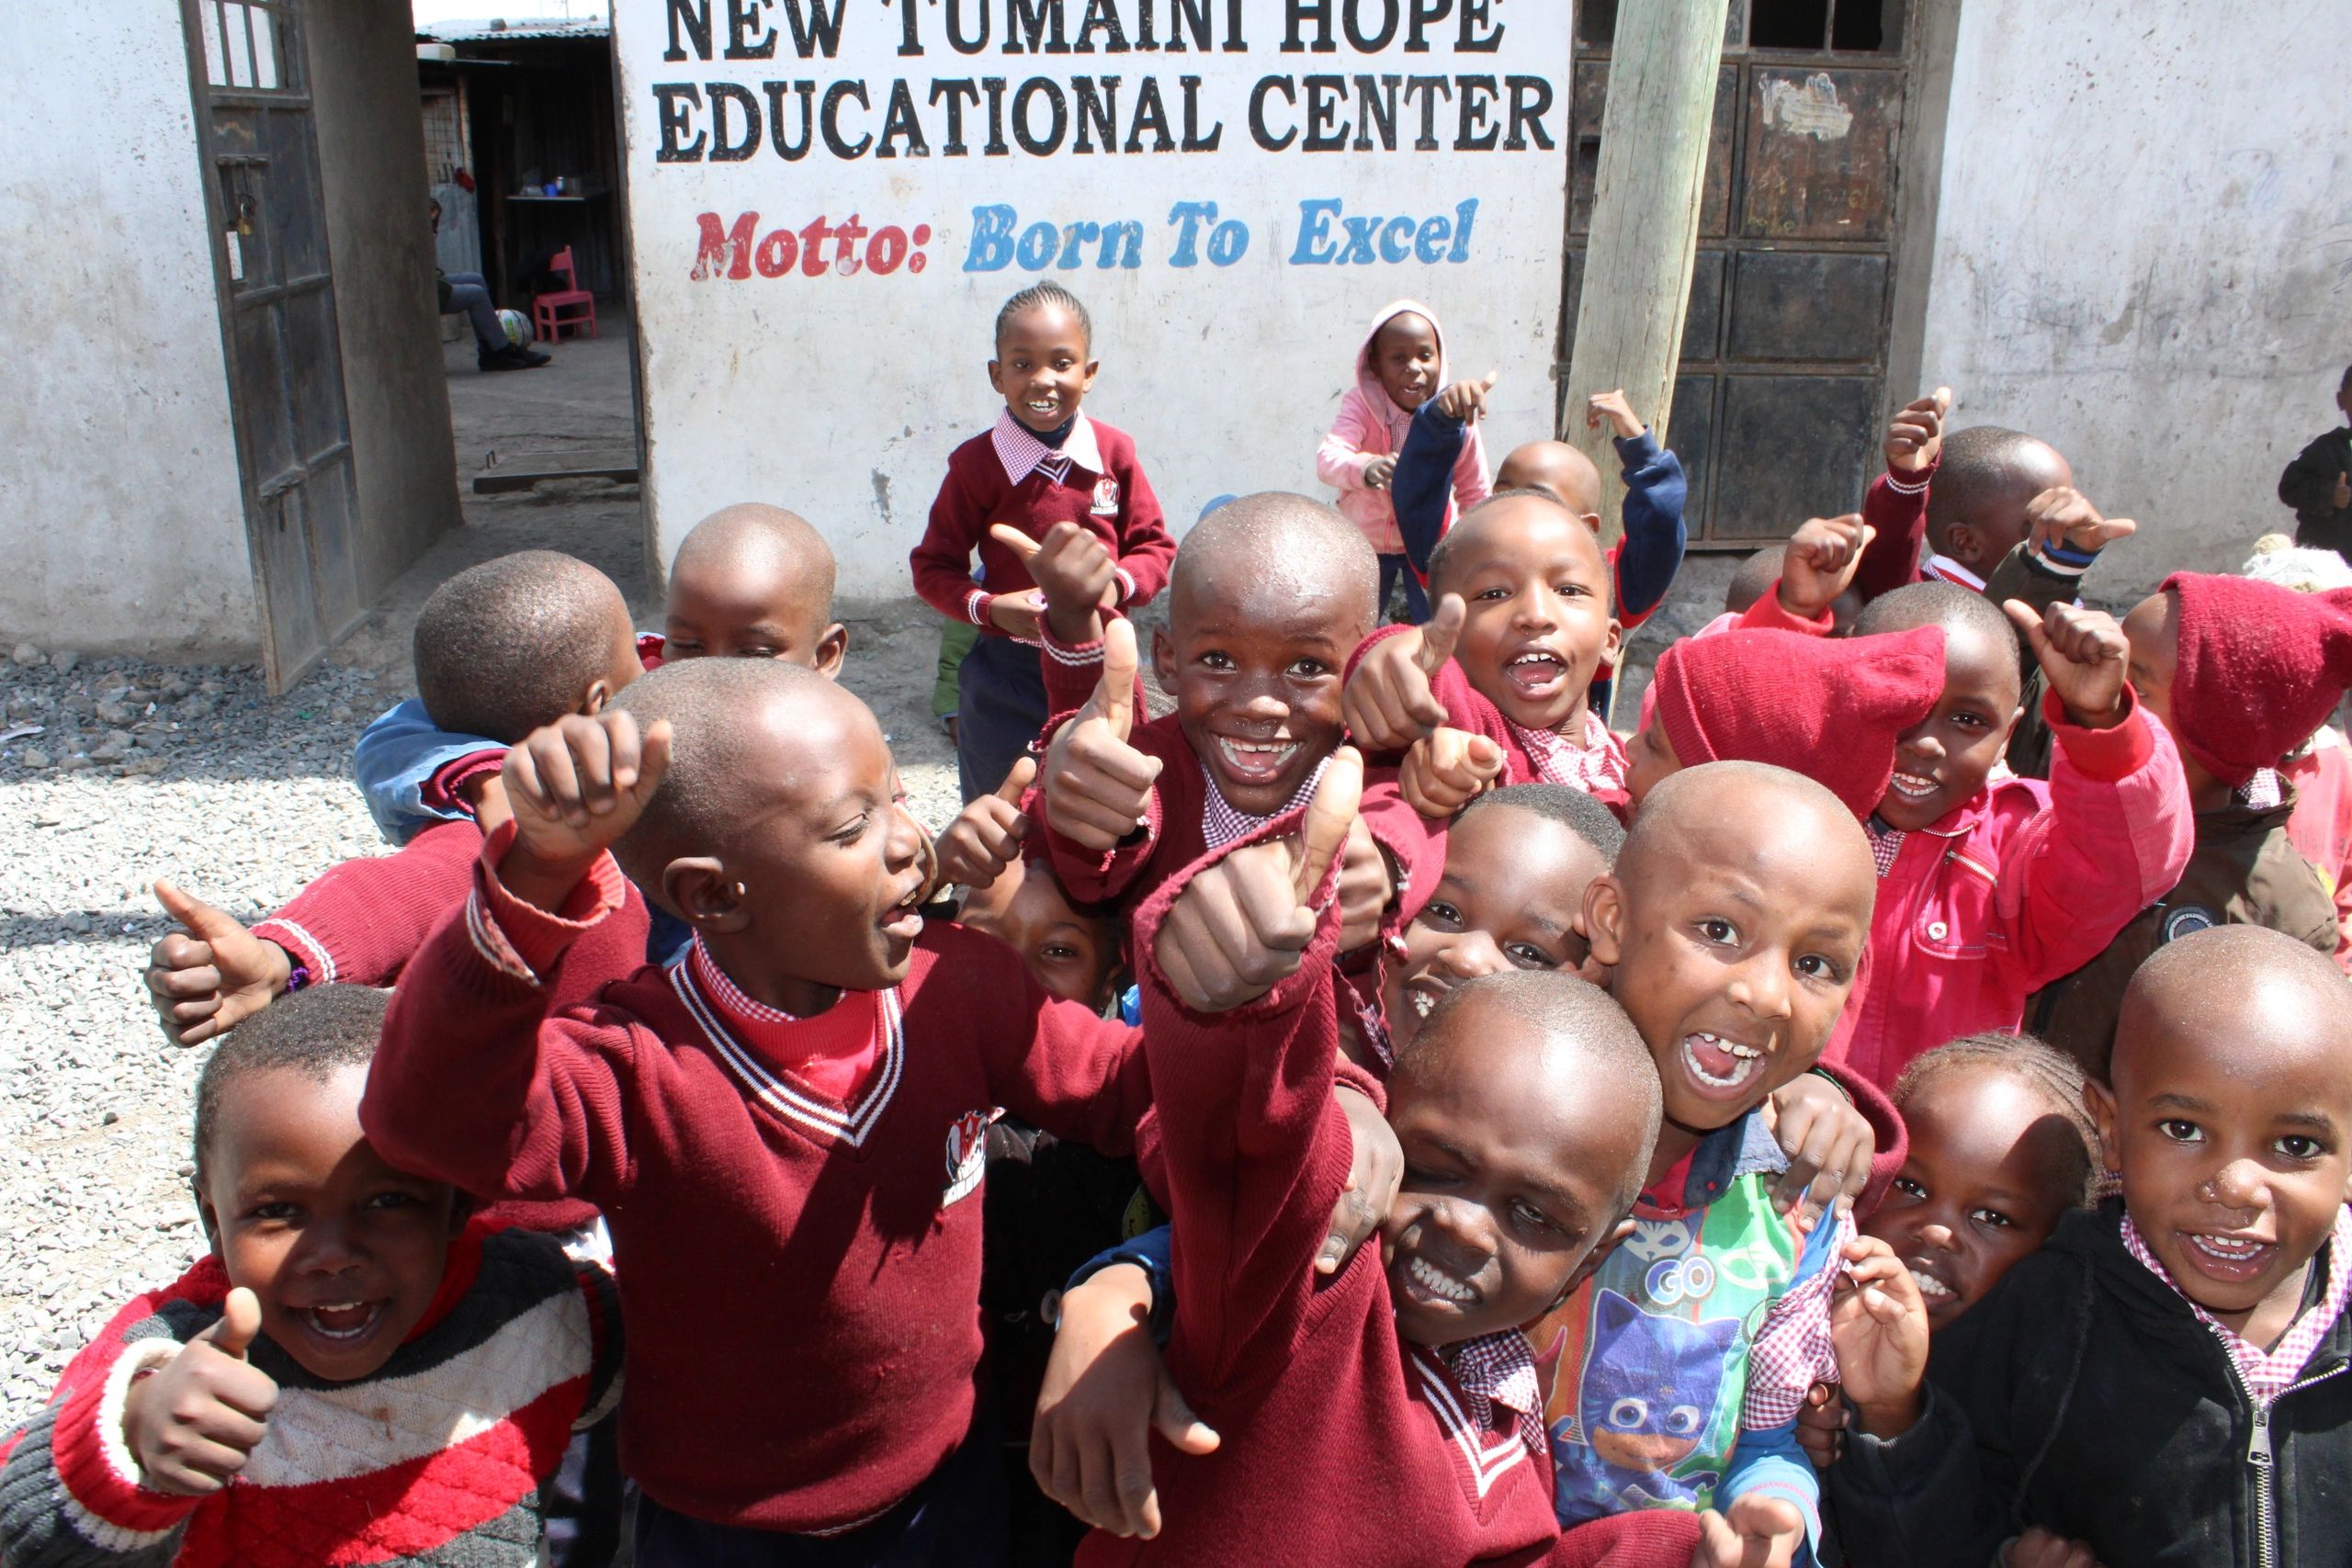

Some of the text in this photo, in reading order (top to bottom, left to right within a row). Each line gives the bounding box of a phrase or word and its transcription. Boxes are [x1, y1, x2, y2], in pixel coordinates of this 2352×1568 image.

[663, 0, 1505, 62] NEW TUMAINI HOPE
[652, 74, 1555, 163] EDUCATIONAL CENTER
[690, 197, 1479, 281] Motto: Born To Excel
[1645, 1257, 1714, 1305] GO
